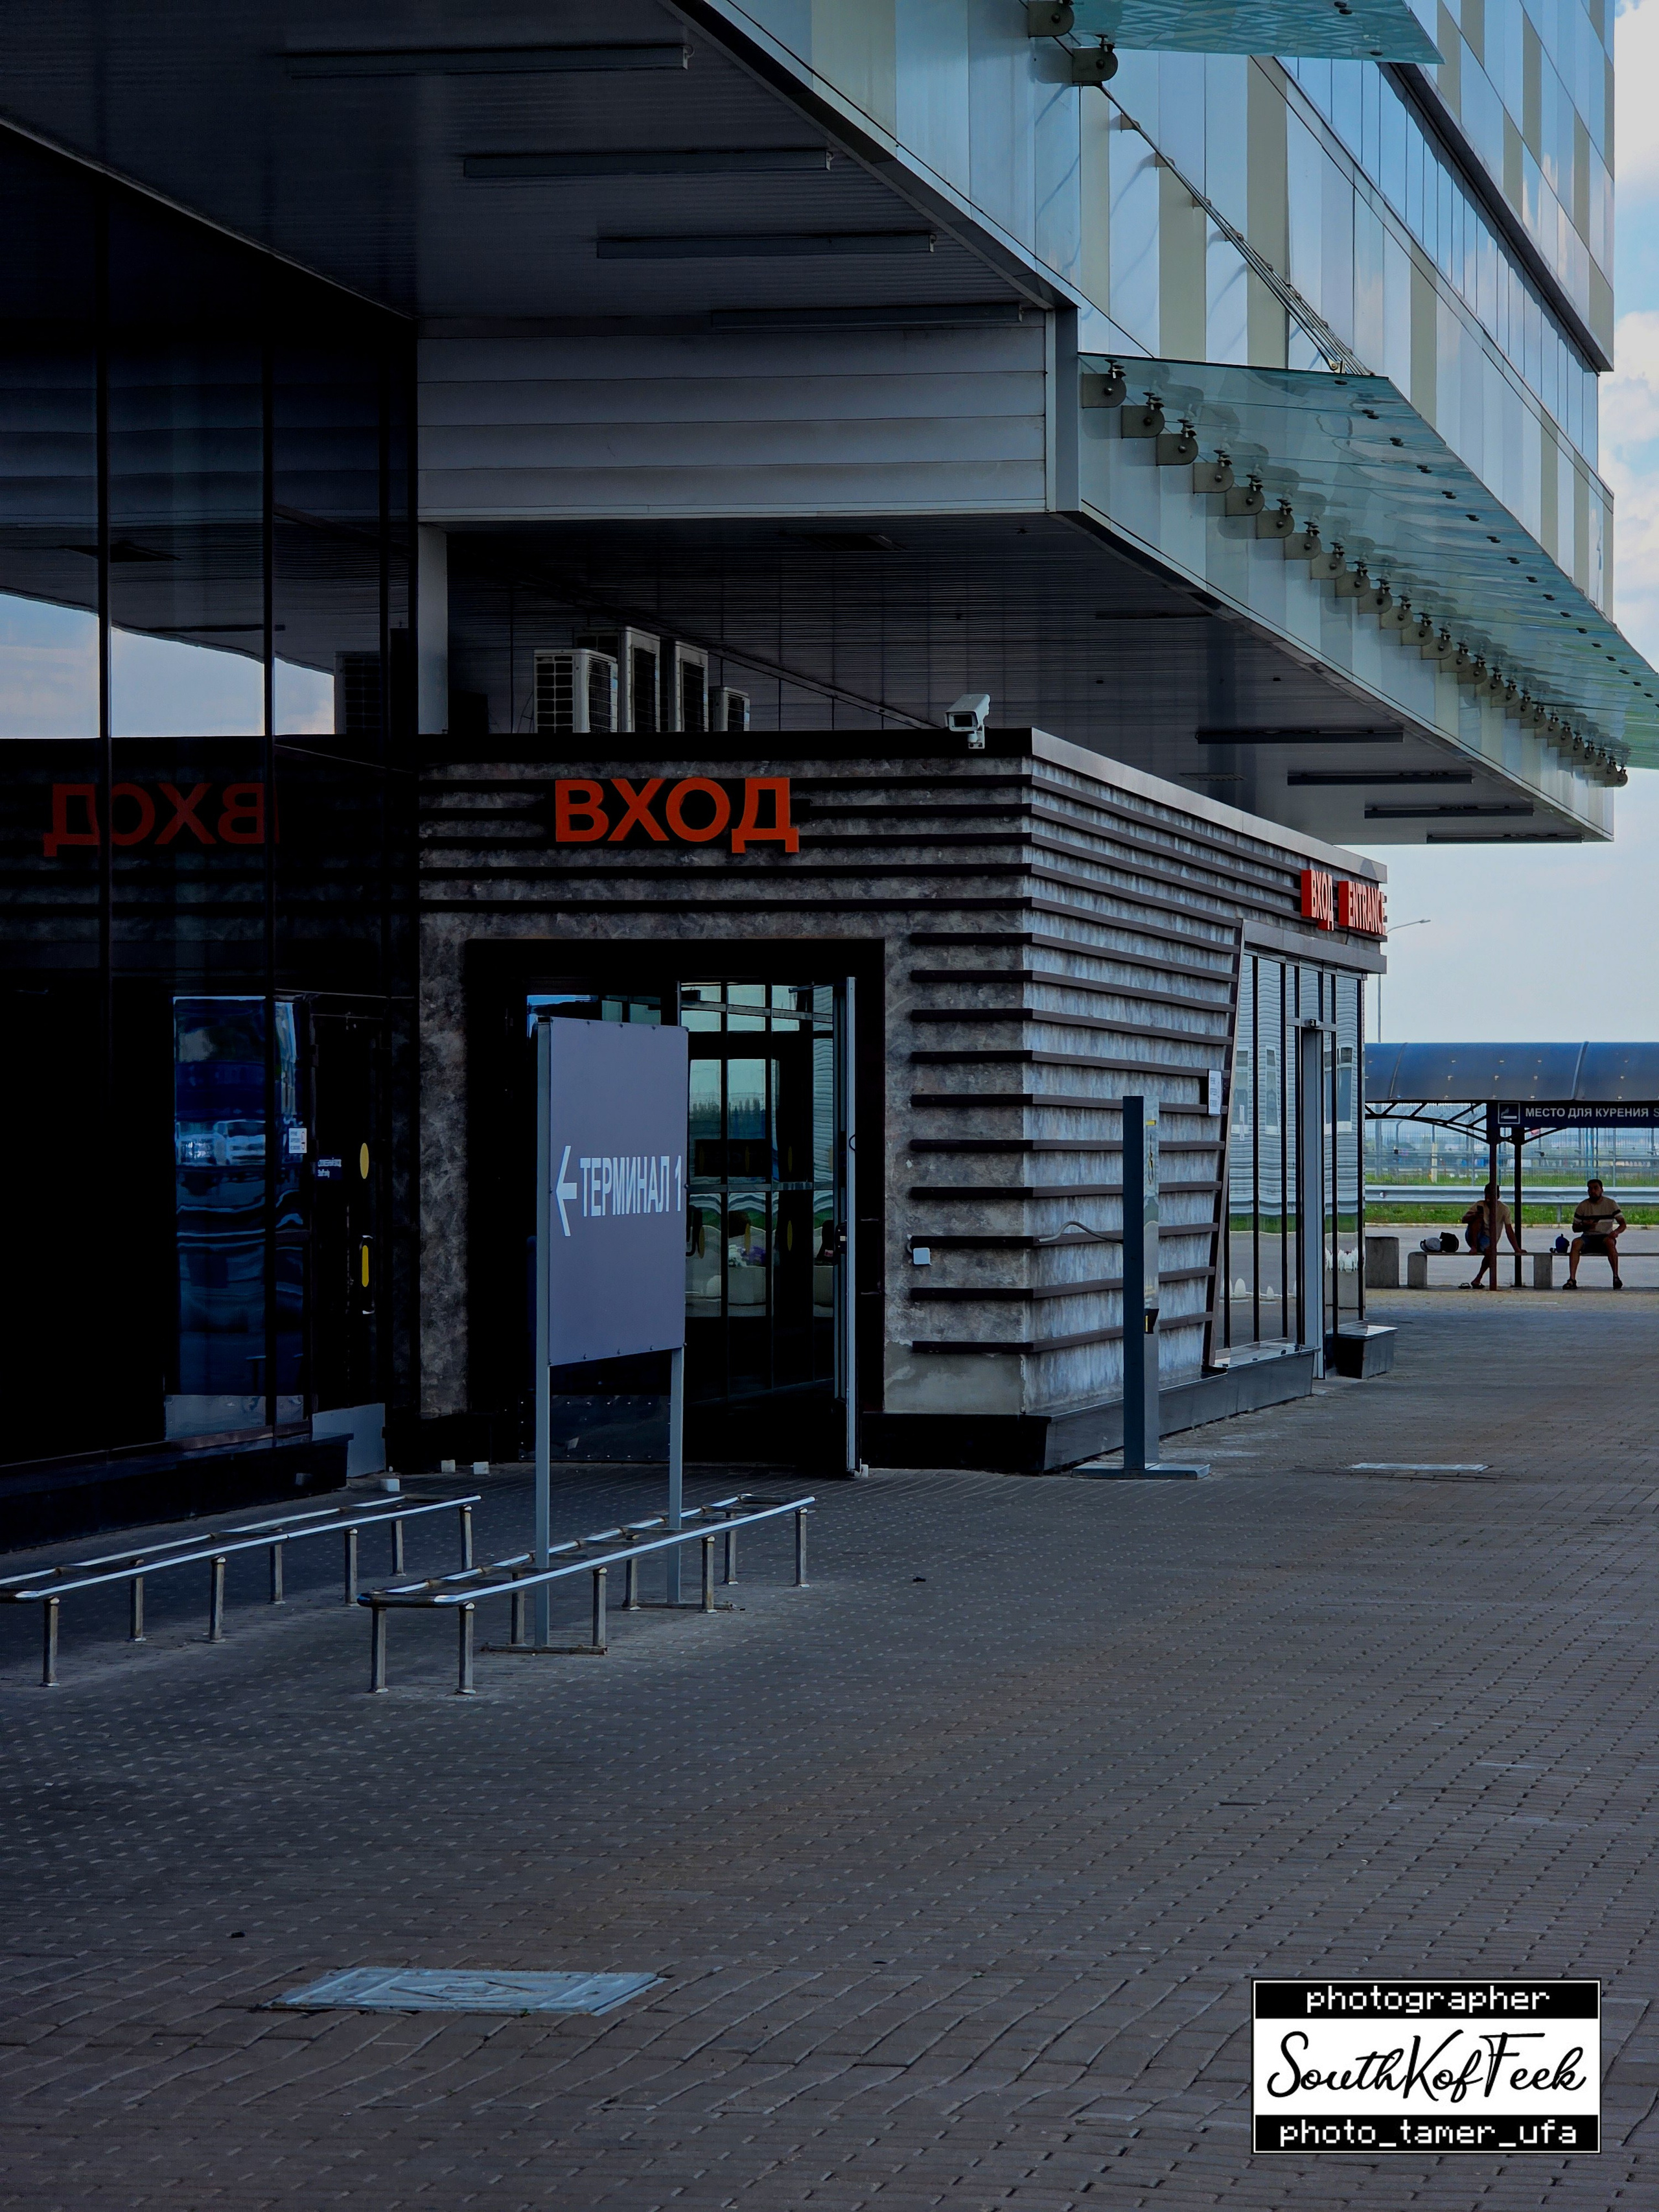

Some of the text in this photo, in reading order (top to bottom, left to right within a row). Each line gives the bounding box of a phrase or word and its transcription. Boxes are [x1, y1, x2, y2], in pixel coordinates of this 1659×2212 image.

[555, 777, 799, 854] ВХОД
[1310, 869, 1334, 931] ВХОД
[1348, 881, 1386, 935] ENTRANCE
[1525, 1108, 1566, 1117] МЕСТО
[1568, 1108, 1592, 1119] ДЛЯ
[1595, 1108, 1649, 1117] КУРЕНИЯ
[579, 1155, 682, 1218] ТЕРМИНАЛ 1
